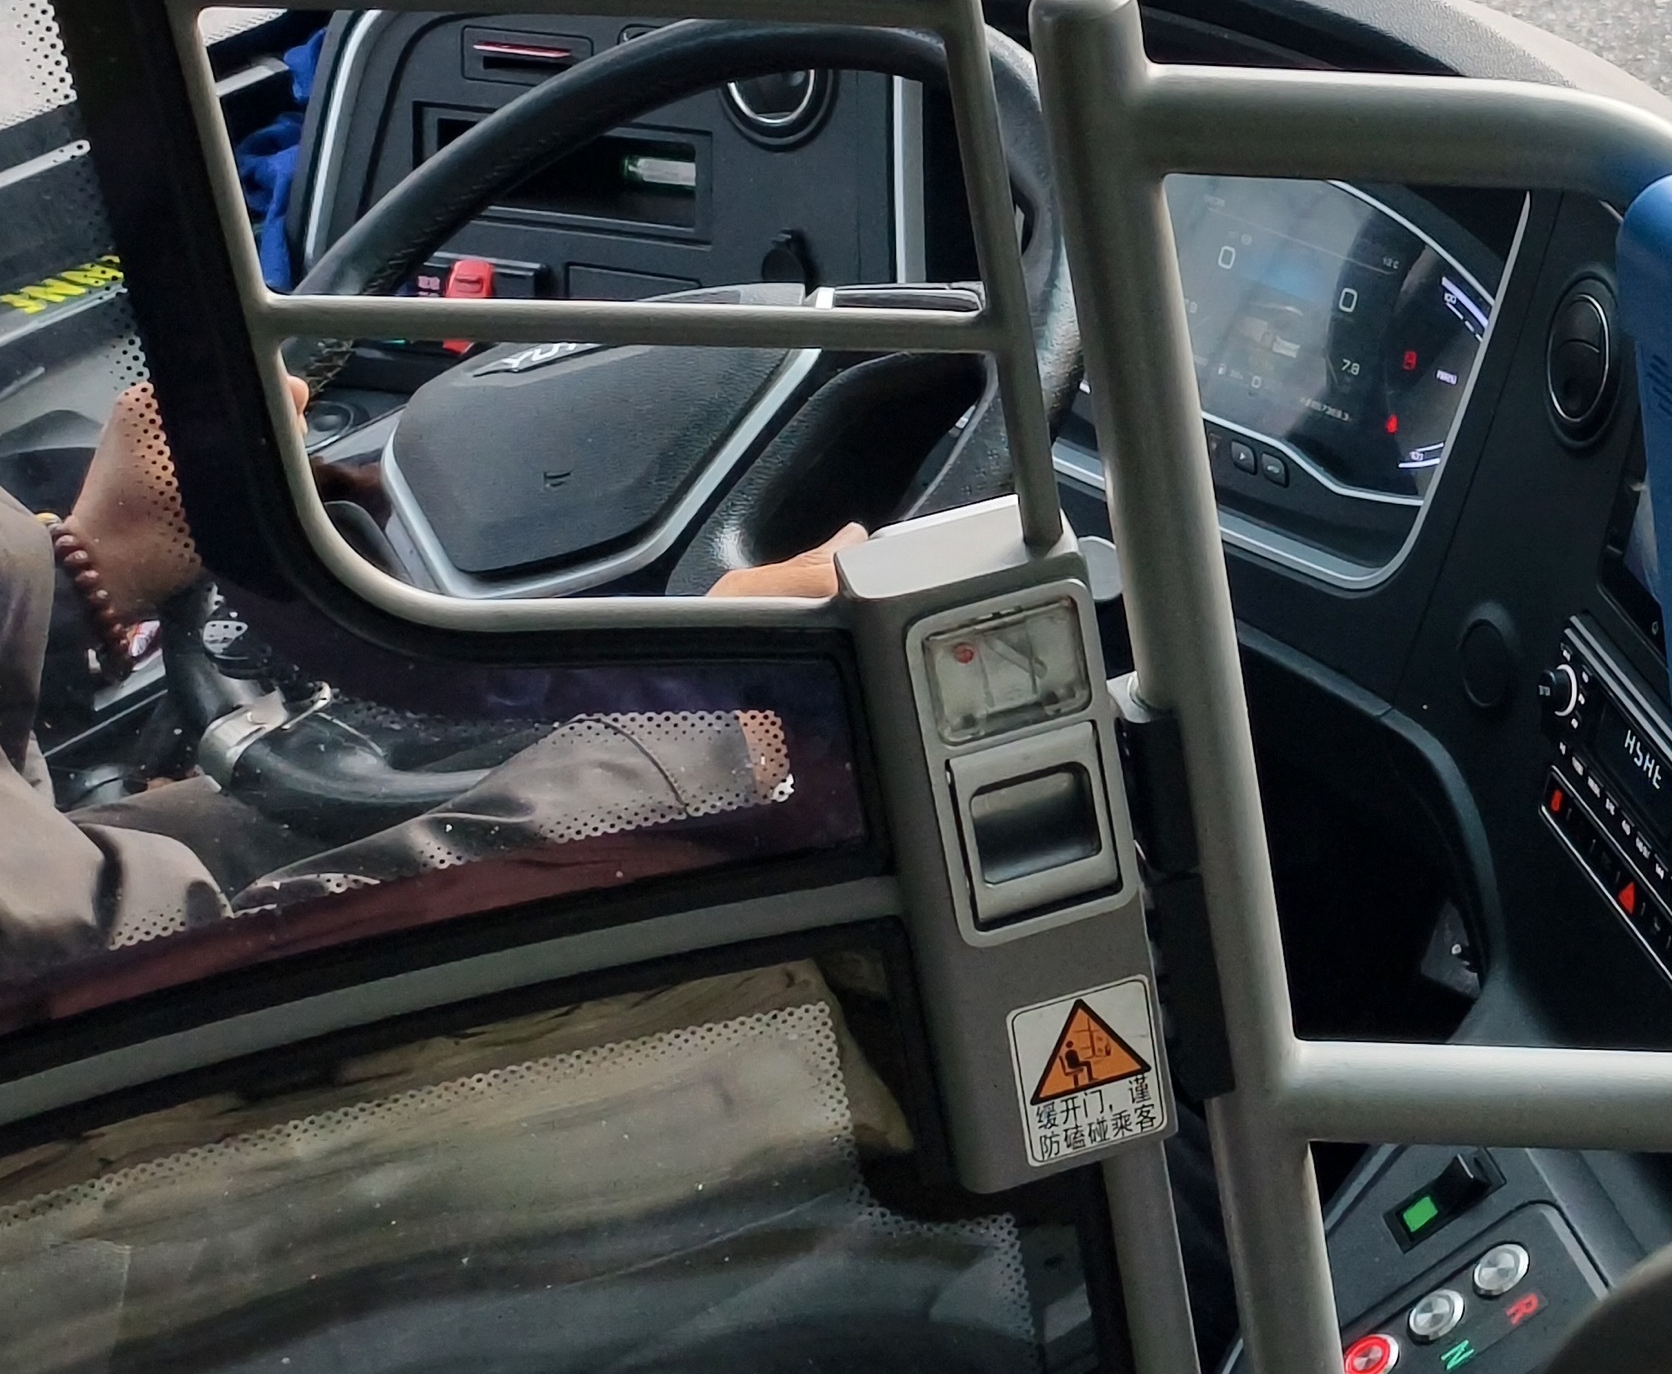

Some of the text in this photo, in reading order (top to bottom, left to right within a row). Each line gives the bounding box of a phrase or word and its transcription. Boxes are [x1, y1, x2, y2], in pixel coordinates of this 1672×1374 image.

[1039, 1103, 1157, 1161] 防磕碰乘客
[1505, 1291, 1540, 1326] R
[1440, 1338, 1476, 1372] N
